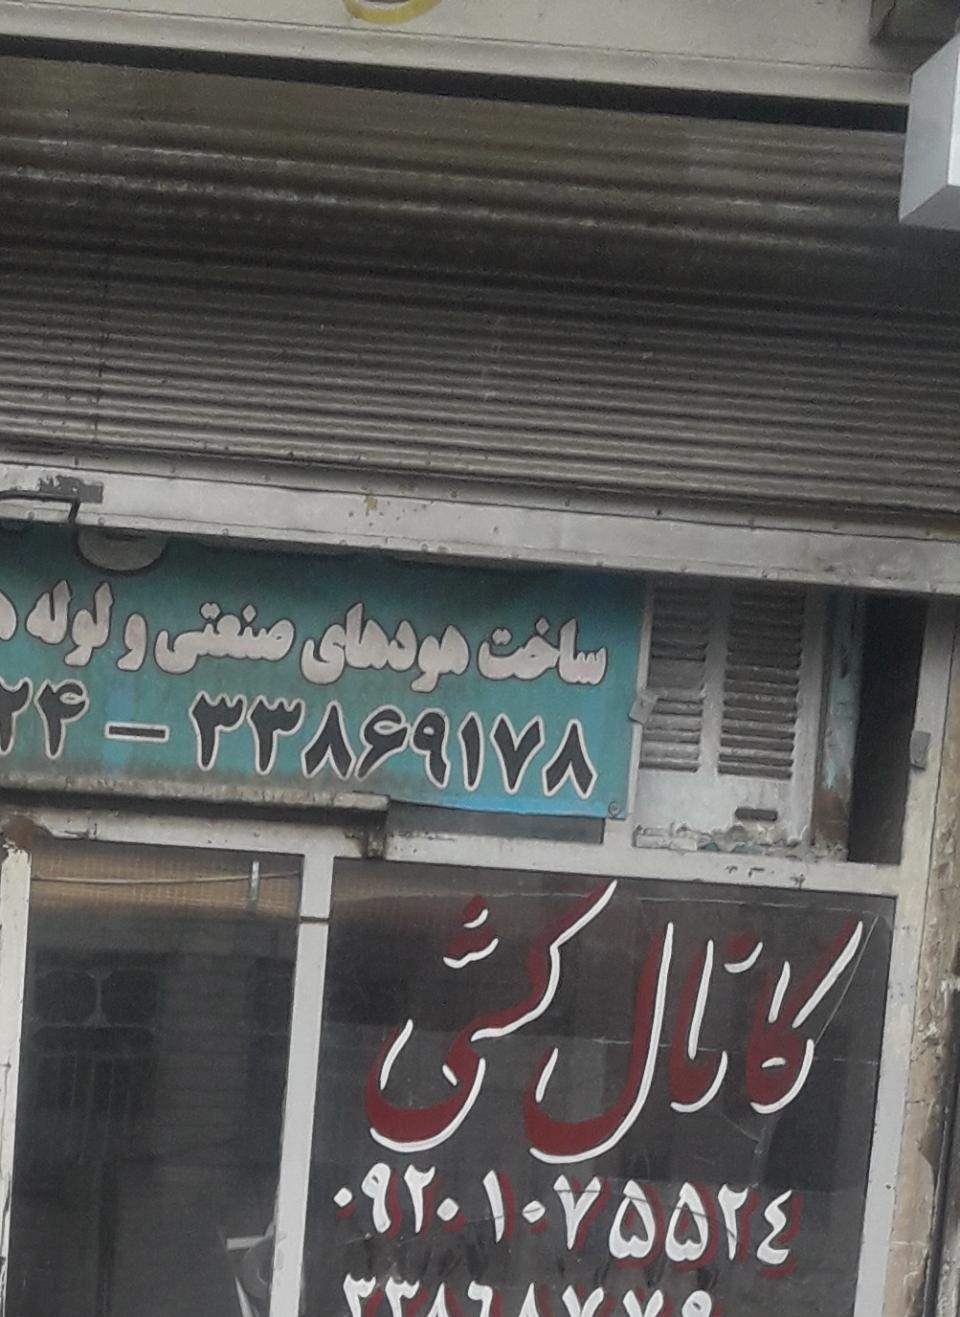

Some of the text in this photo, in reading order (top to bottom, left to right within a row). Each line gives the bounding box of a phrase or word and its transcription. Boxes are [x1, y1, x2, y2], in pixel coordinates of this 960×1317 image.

[116, 613, 147, 671] و
[153, 602, 296, 675] صنعتی
[300, 602, 470, 693] هودهای
[477, 617, 608, 685] ساخت
[188, 691, 599, 798] ۳۳۸۶۹۱۷۸
[365, 878, 863, 1164] کانال کشی
